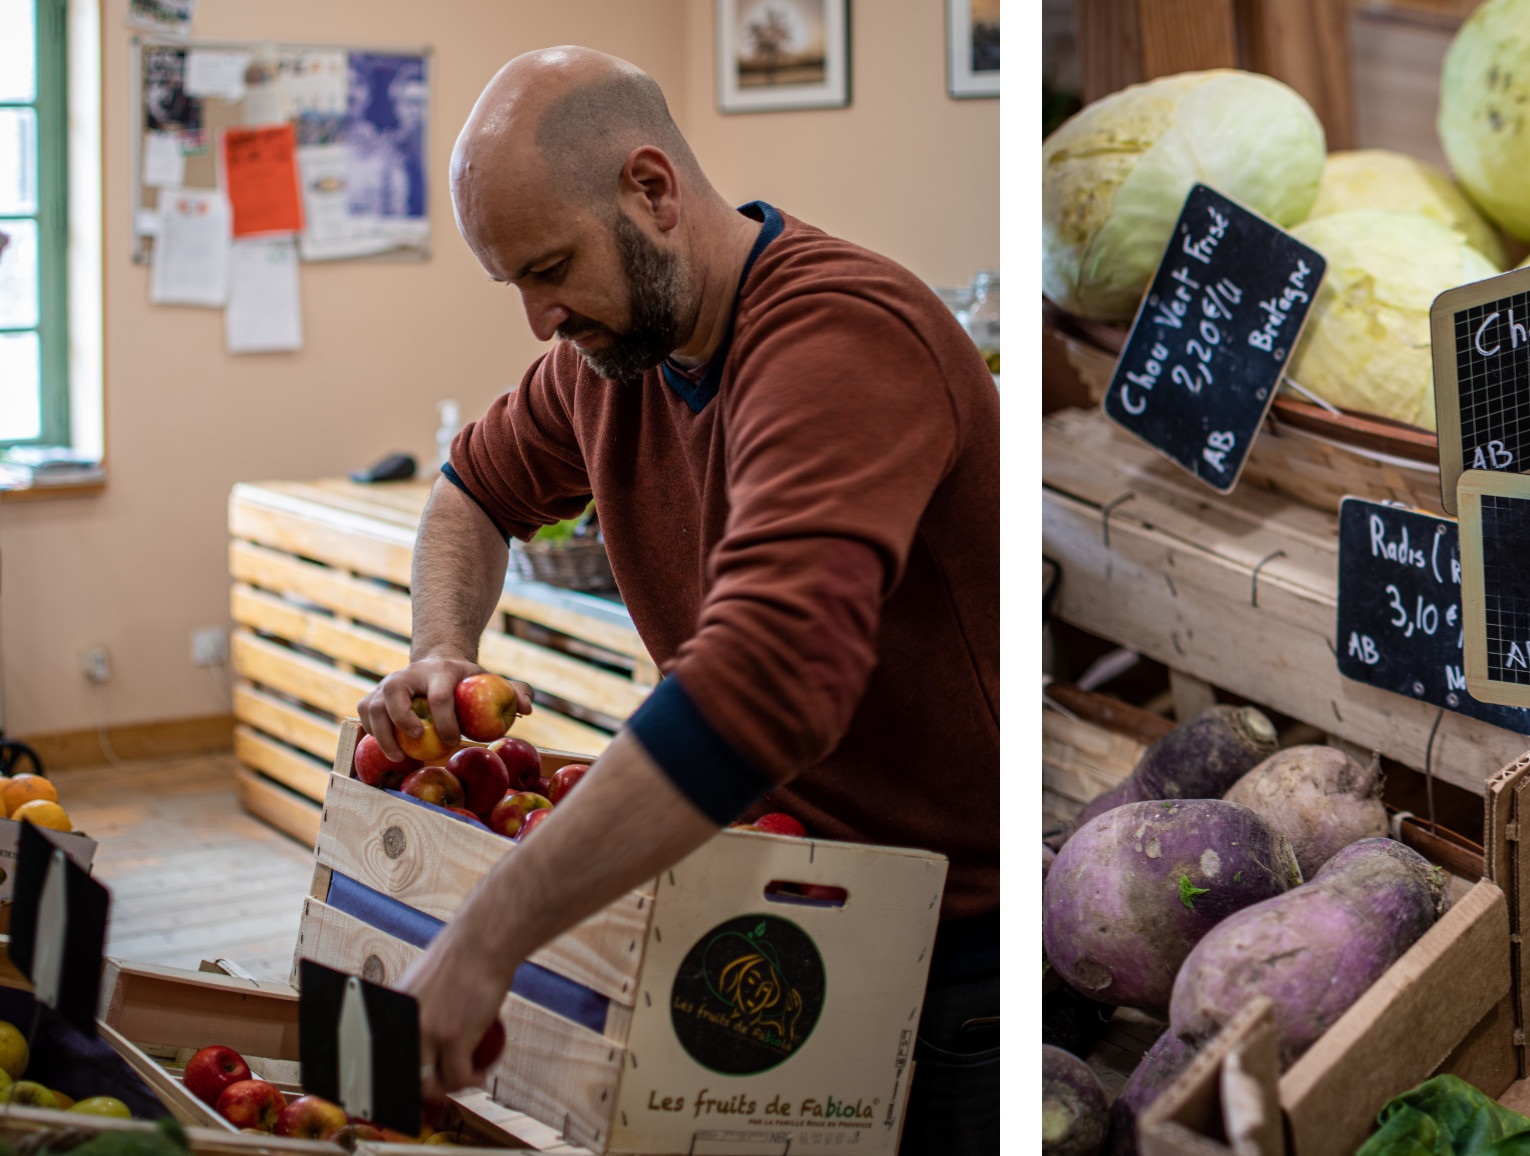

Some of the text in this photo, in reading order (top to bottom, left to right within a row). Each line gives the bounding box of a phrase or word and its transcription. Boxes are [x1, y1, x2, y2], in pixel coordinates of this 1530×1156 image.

[1248, 258, 1312, 352] Bretagne
[1120, 342, 1168, 415] Chou
[1154, 266, 1200, 329] Vert
[1202, 430, 1236, 474] AB
[1471, 439, 1514, 471] AB
[1369, 513, 1426, 569] Radis
[1347, 631, 1381, 666] AB
[674, 996, 694, 1013] Les
[695, 1003, 731, 1028] fruits
[733, 1020, 749, 1035] de
[647, 1089, 685, 1113] Les
[693, 1088, 758, 1119] fruits
[764, 1094, 792, 1117] de
